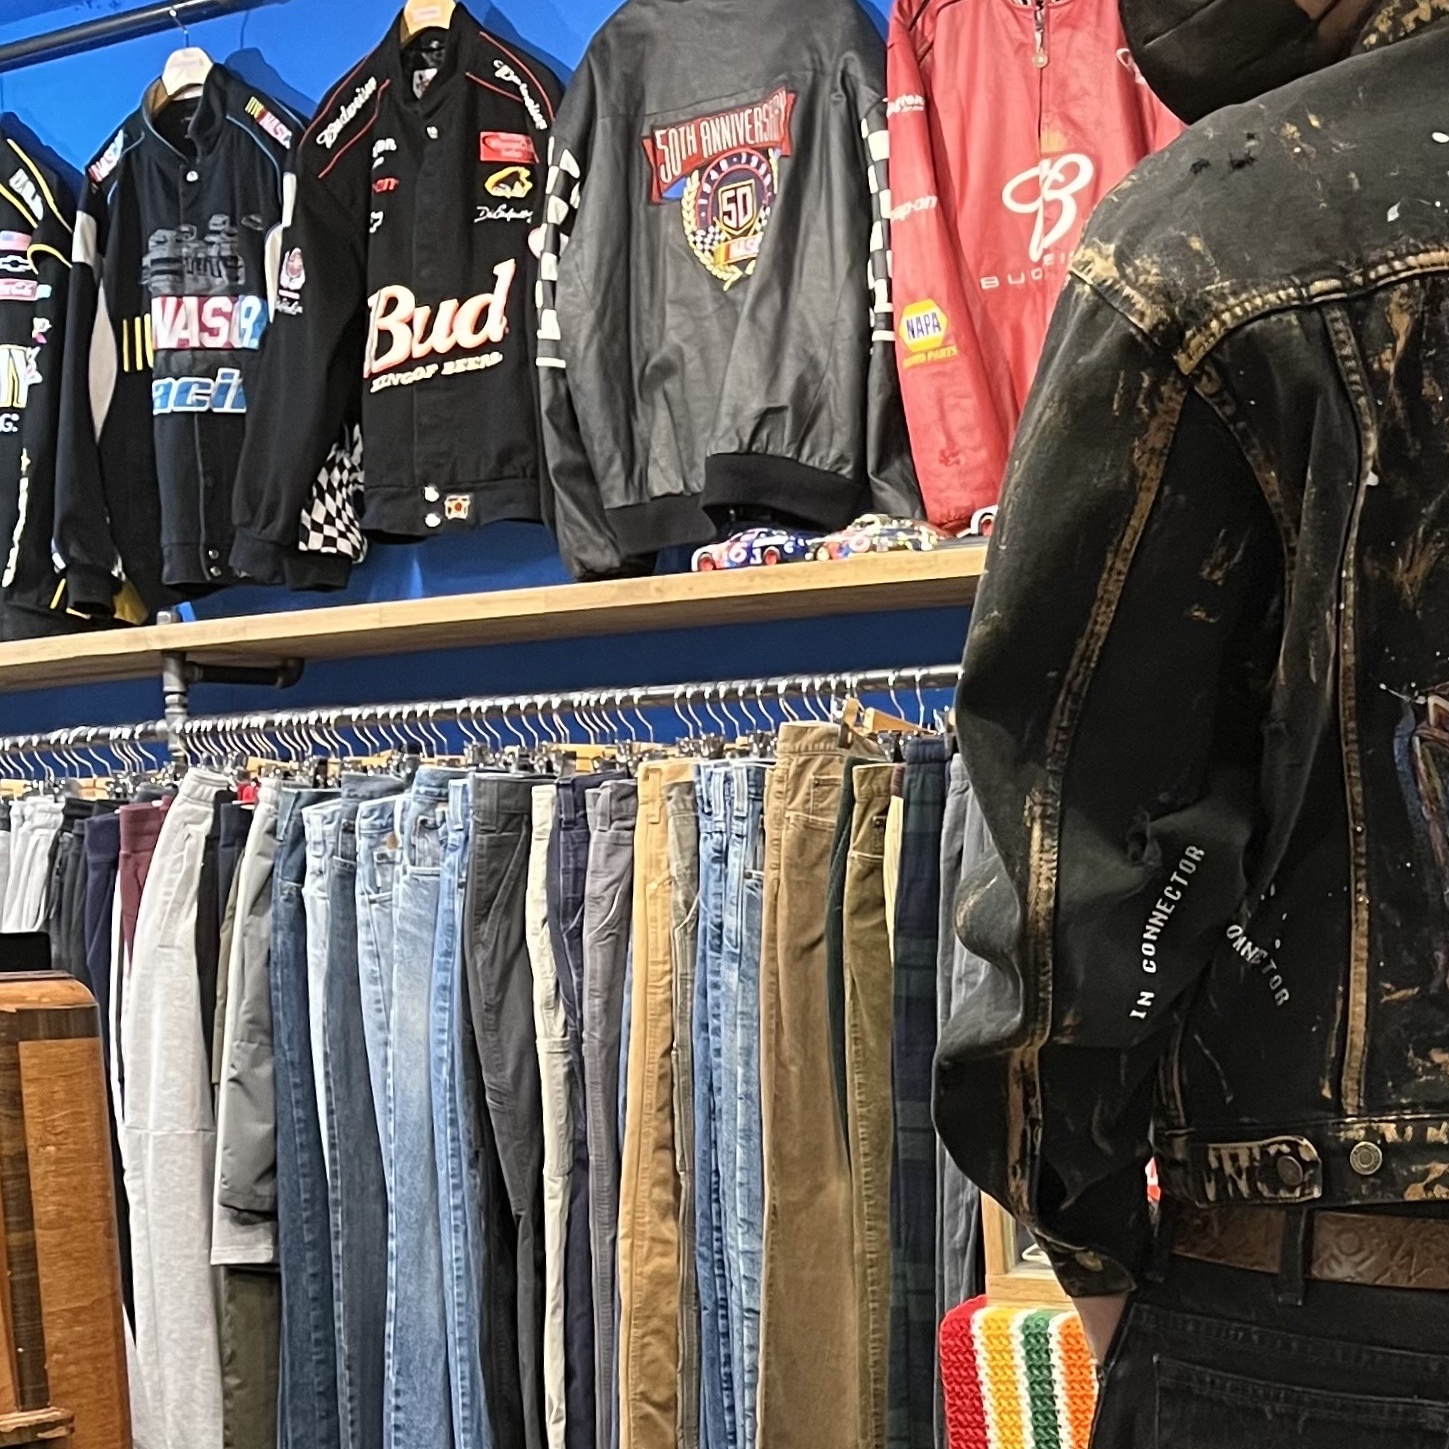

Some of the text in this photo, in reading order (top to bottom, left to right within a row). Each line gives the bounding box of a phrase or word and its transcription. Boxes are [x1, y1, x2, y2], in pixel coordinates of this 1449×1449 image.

[655, 125, 698, 184] 50TH
[721, 185, 754, 230] 50
[363, 258, 516, 378] Bud
[906, 311, 942, 341] NAPA
[1129, 845, 1205, 1019] IN CONNECTOR
